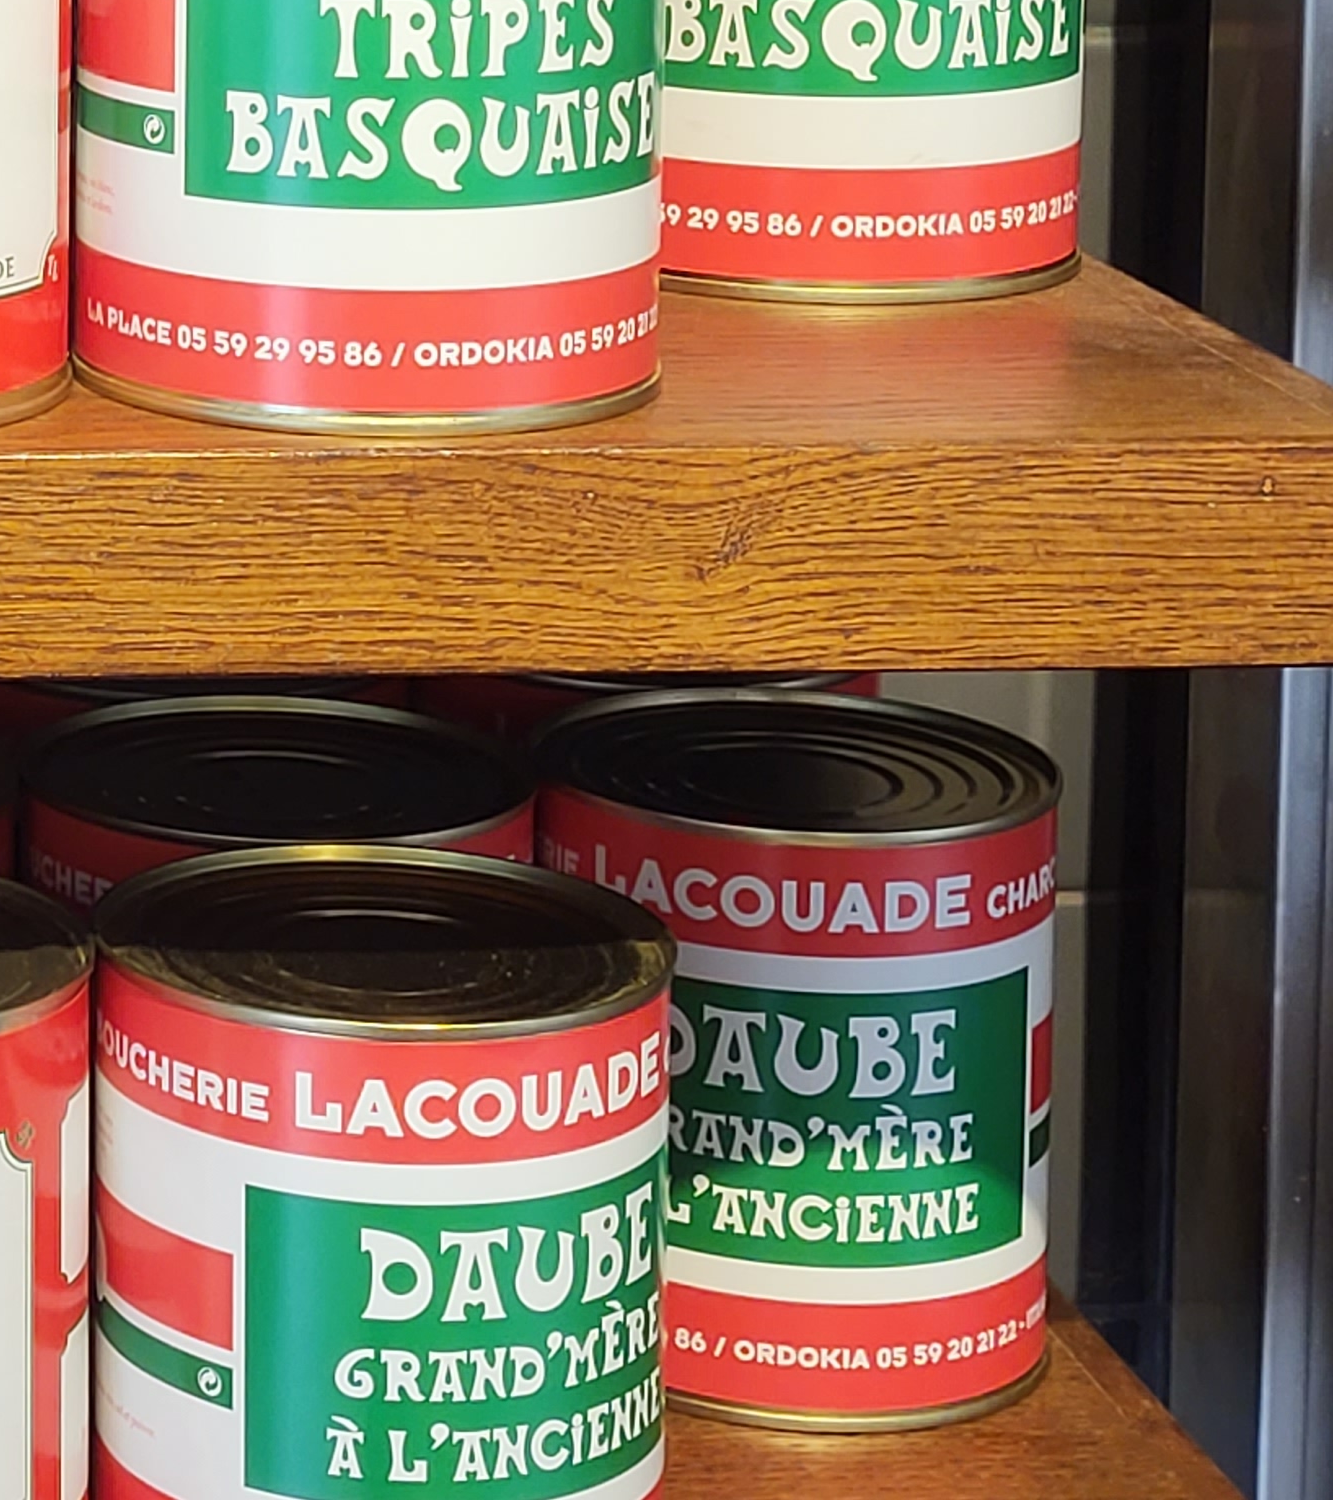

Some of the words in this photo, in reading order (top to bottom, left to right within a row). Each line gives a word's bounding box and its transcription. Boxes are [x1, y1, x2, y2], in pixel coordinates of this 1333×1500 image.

[686, 205, 720, 231] 29
[725, 209, 760, 235] 95
[766, 212, 802, 237] 86
[830, 213, 964, 239] ORDOKIA
[969, 208, 997, 233] 05
[1000, 206, 1025, 231] 59
[107, 305, 173, 347] PLACE
[177, 324, 207, 353] 05
[212, 330, 248, 358] 59
[253, 335, 291, 362] 29
[298, 338, 337, 366] 95
[343, 341, 383, 368] 86
[413, 335, 555, 368] ORDOKIA
[559, 329, 587, 358] 05
[591, 323, 615, 352] 59
[594, 843, 972, 935] LACOUADE
[99, 1016, 270, 1124] OUCHERIE
[295, 1031, 662, 1139] LACOUADE
[669, 1104, 973, 1171] RAND'MÈRE
[360, 1181, 654, 1324] DAUBE
[674, 1327, 707, 1354] 86
[733, 1340, 871, 1370] ORDOKIA
[876, 1345, 908, 1368] 05
[912, 1342, 943, 1366] 59
[946, 1337, 973, 1361] 20
[326, 1414, 366, 1479] À
